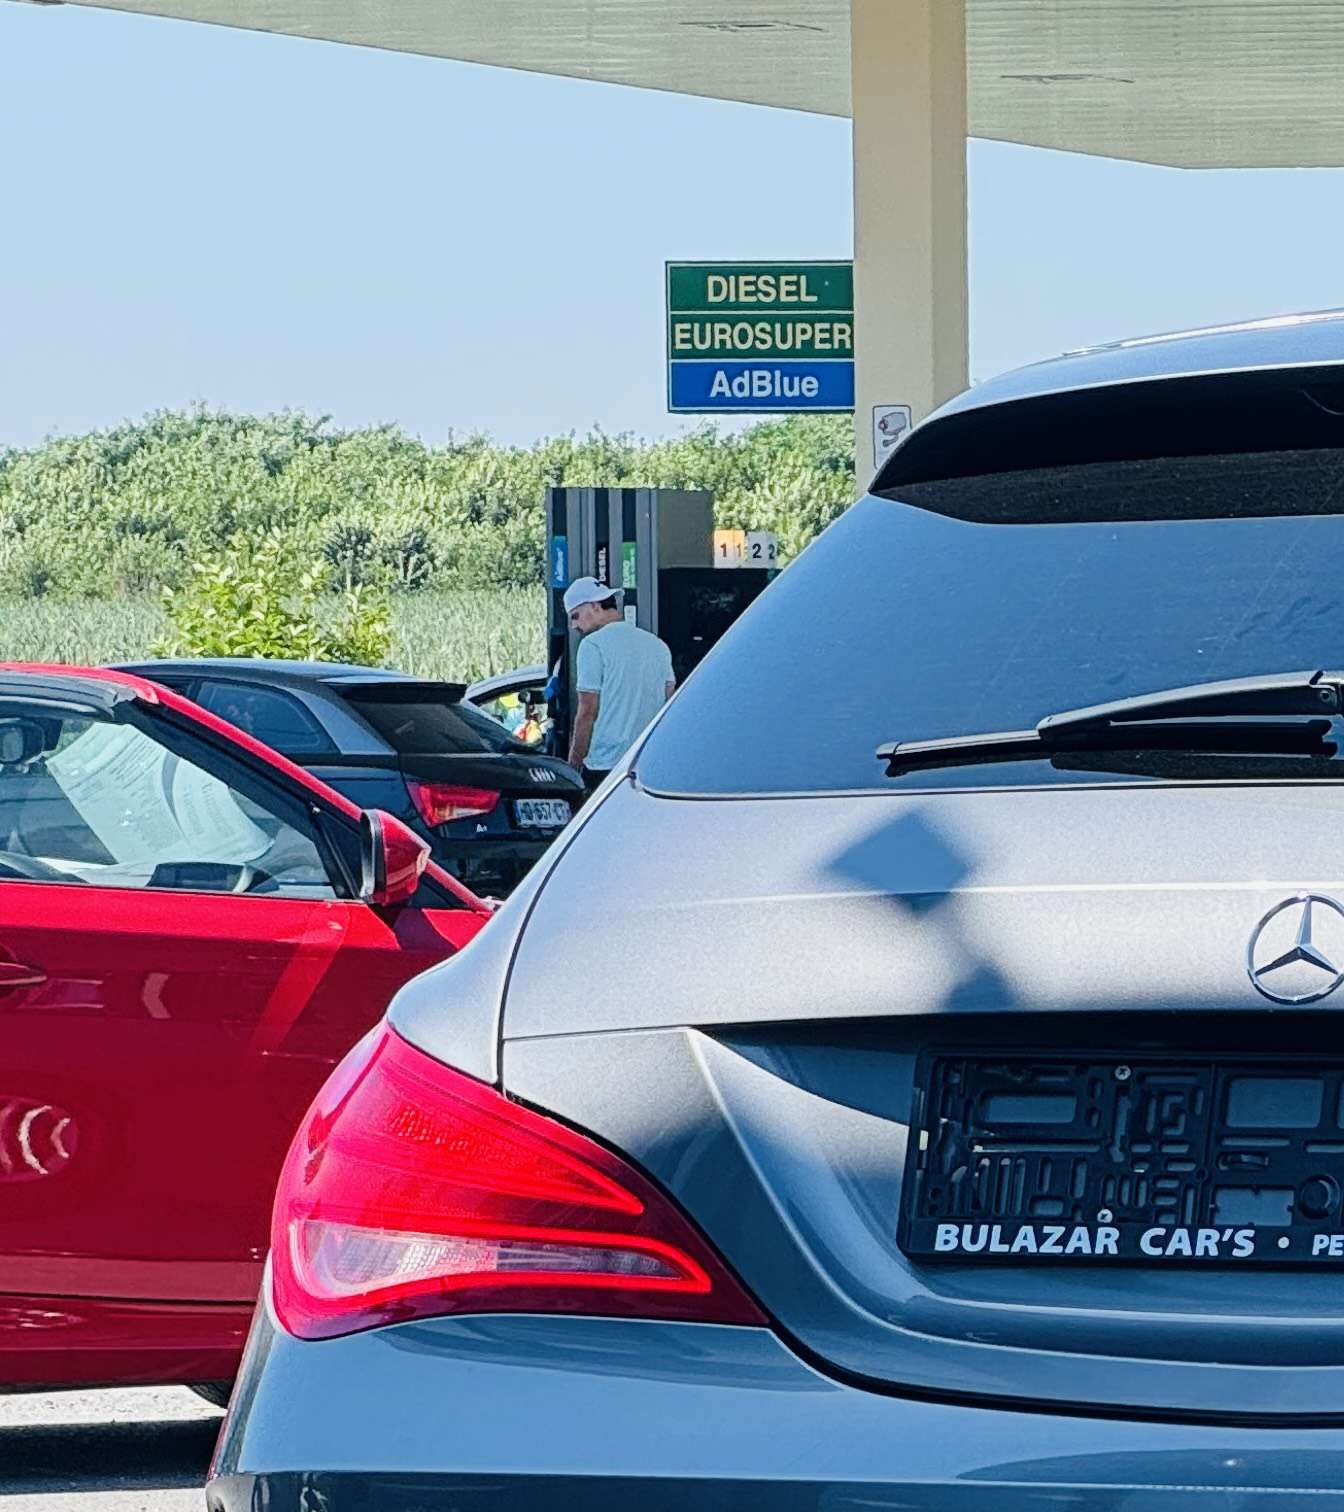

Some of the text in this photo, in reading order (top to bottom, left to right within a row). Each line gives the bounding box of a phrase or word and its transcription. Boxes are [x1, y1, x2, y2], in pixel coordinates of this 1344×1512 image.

[707, 275, 818, 303] DIESEL
[674, 322, 851, 350] EUROSUPER
[710, 370, 819, 398] AdBlue
[720, 543, 727, 558] 1
[752, 543, 762, 559] 2
[934, 1223, 1120, 1256] BULAZAR
[1140, 1227, 1256, 1258] CAR'S
